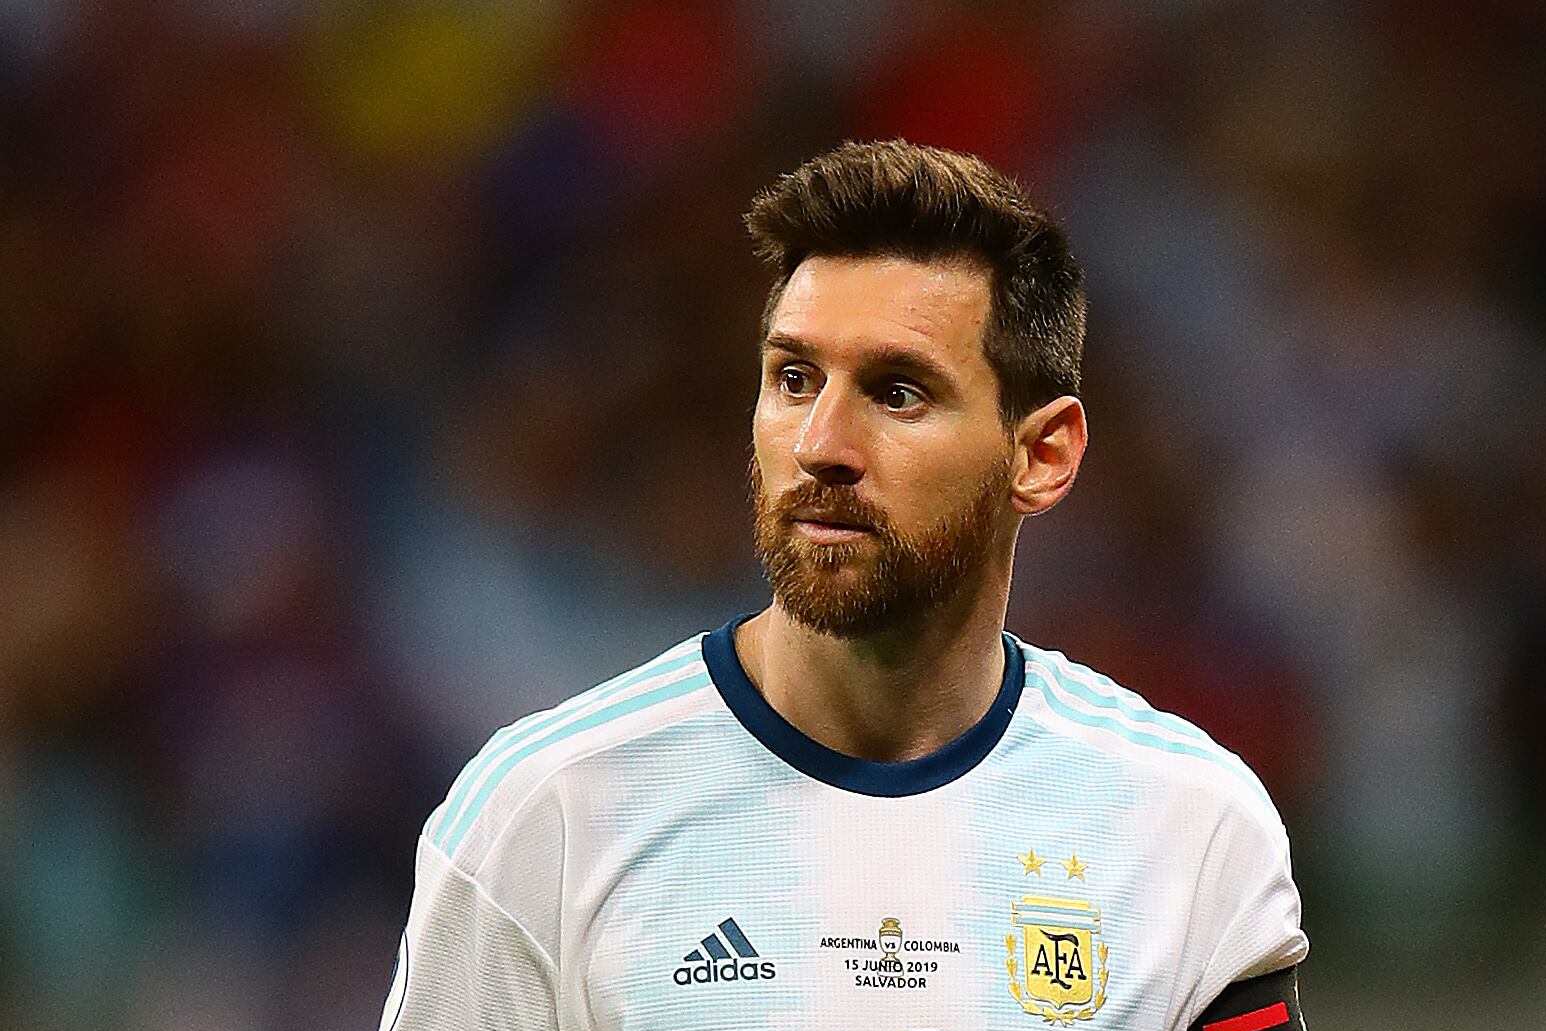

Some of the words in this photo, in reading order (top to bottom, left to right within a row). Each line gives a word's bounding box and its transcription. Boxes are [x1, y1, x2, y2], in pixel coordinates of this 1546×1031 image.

[820, 937, 877, 950] ARGENTINA
[904, 940, 960, 953] COLOMBIA
[844, 959, 859, 970] 15
[862, 960, 903, 972] JUNIO
[907, 961, 938, 973] 2019
[1031, 929, 1087, 990] AFA
[673, 958, 776, 986] adidas
[855, 975, 927, 988] SALVADOR
